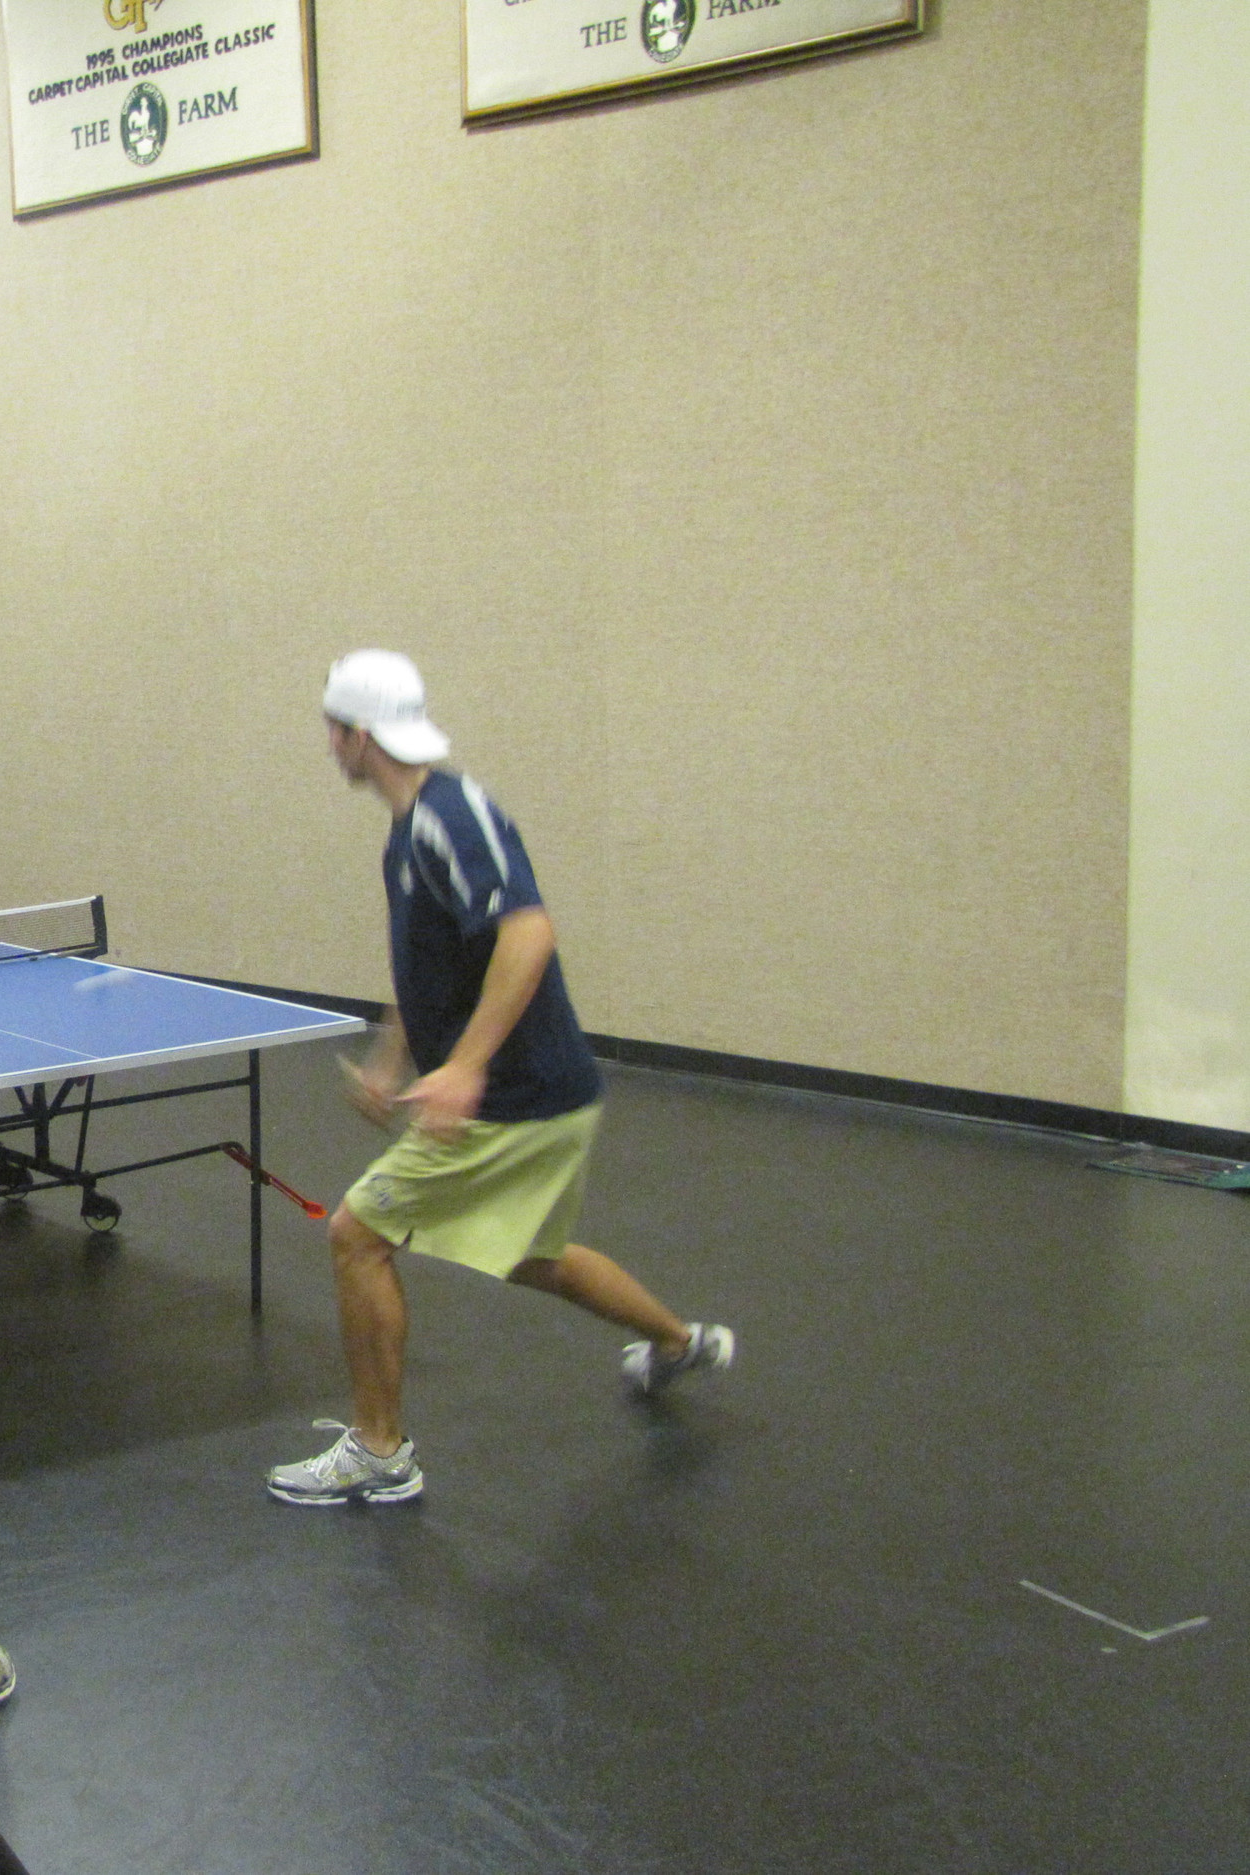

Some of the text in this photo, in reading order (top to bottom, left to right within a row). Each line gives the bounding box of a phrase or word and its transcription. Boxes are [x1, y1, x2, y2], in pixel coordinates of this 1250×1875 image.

[86, 25, 203, 71] 1995 CHAMPIONS
[580, 17, 627, 48] THE
[28, 23, 276, 105] CARPET CAPITAL COLLEGIATE CLASSIC
[71, 119, 110, 150] THE
[177, 87, 238, 125] FARM
